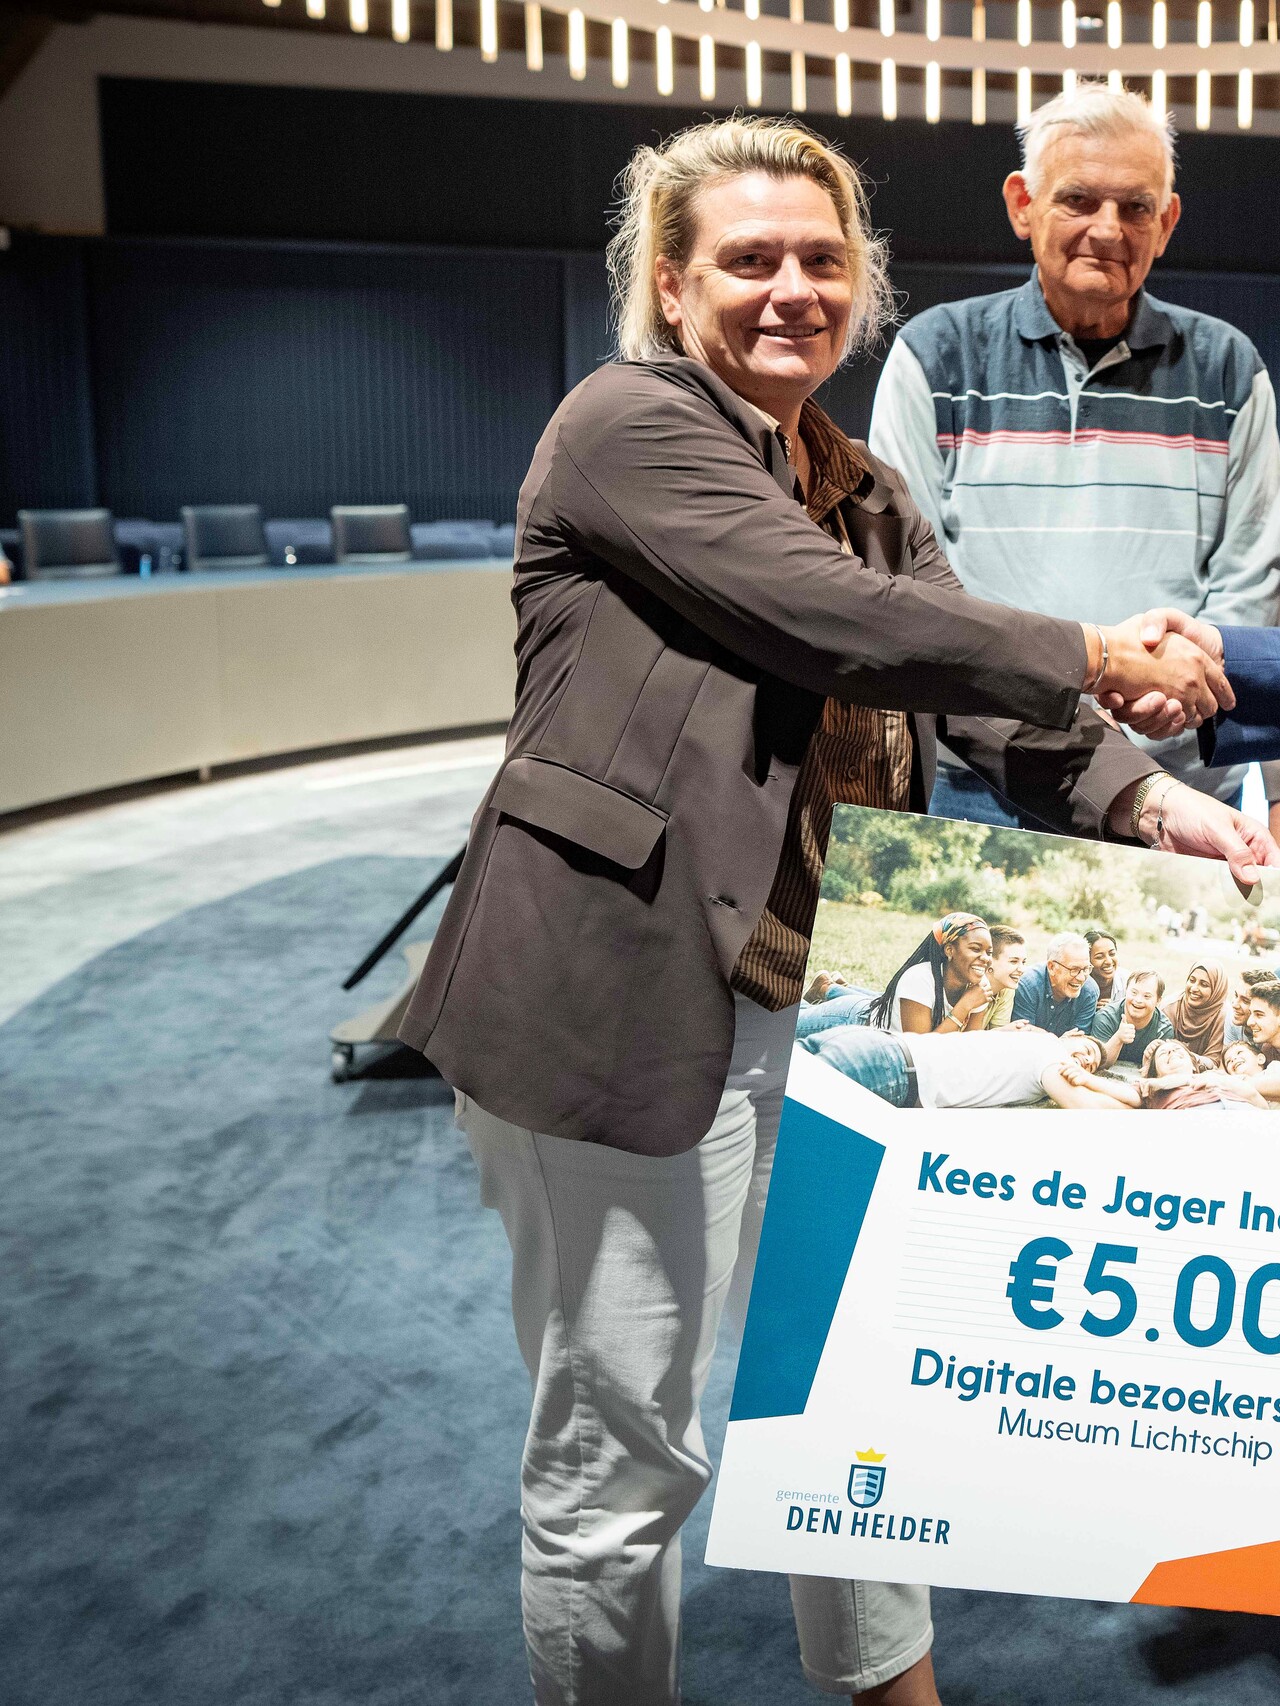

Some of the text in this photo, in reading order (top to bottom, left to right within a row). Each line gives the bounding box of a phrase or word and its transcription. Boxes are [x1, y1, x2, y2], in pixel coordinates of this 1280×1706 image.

[918, 1152, 1015, 1201] Kees
[1032, 1171, 1086, 1209] de
[1102, 1176, 1225, 1231] Jager
[911, 1348, 1075, 1401] Digitale
[998, 1407, 1119, 1445] Museum
[1131, 1420, 1272, 1466] Lichtschip
[775, 1489, 840, 1504] gemeente
[786, 1505, 950, 1545] DEN HELDER
